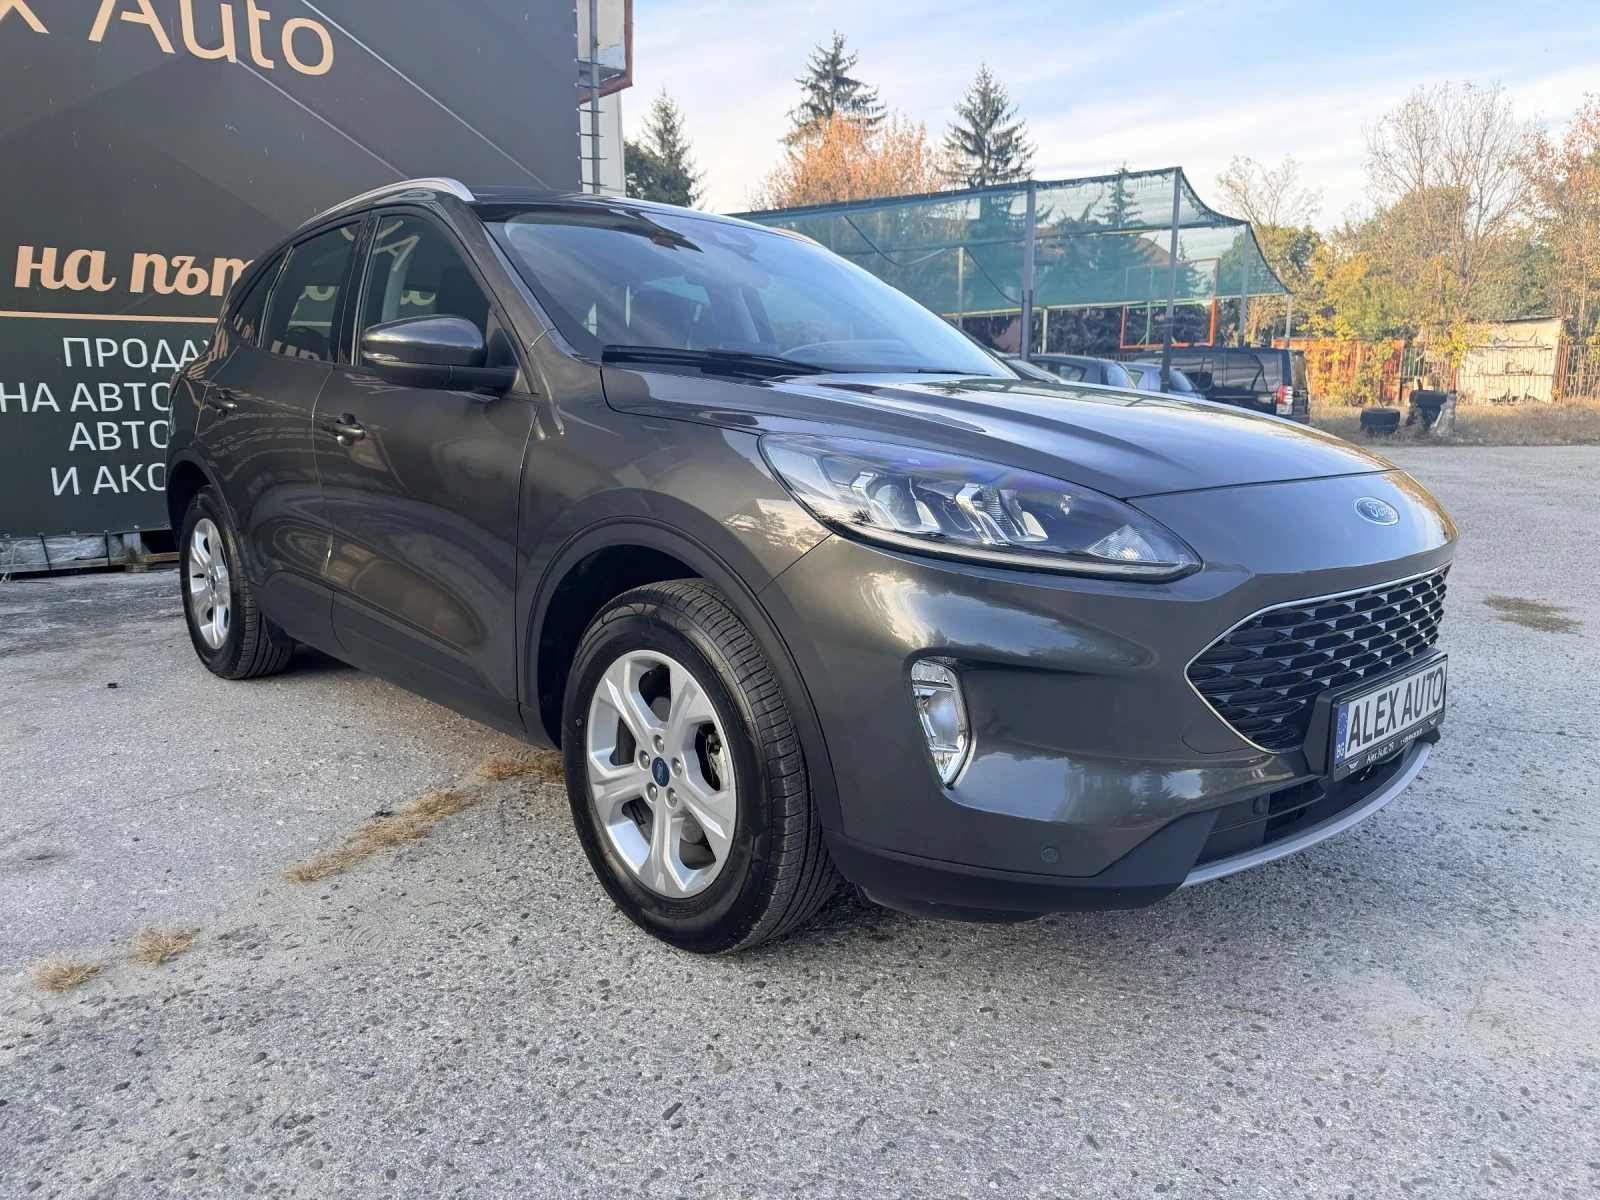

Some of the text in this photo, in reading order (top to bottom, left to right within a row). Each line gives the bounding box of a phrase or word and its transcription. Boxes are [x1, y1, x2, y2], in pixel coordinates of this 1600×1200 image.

[15, 246, 116, 292] на
[62, 337, 210, 373] ПРОДА
[0, 382, 61, 413] НА
[51, 466, 81, 496] И
[1347, 666, 1444, 753] ALEX AUTO
[1336, 741, 1345, 759] BG
